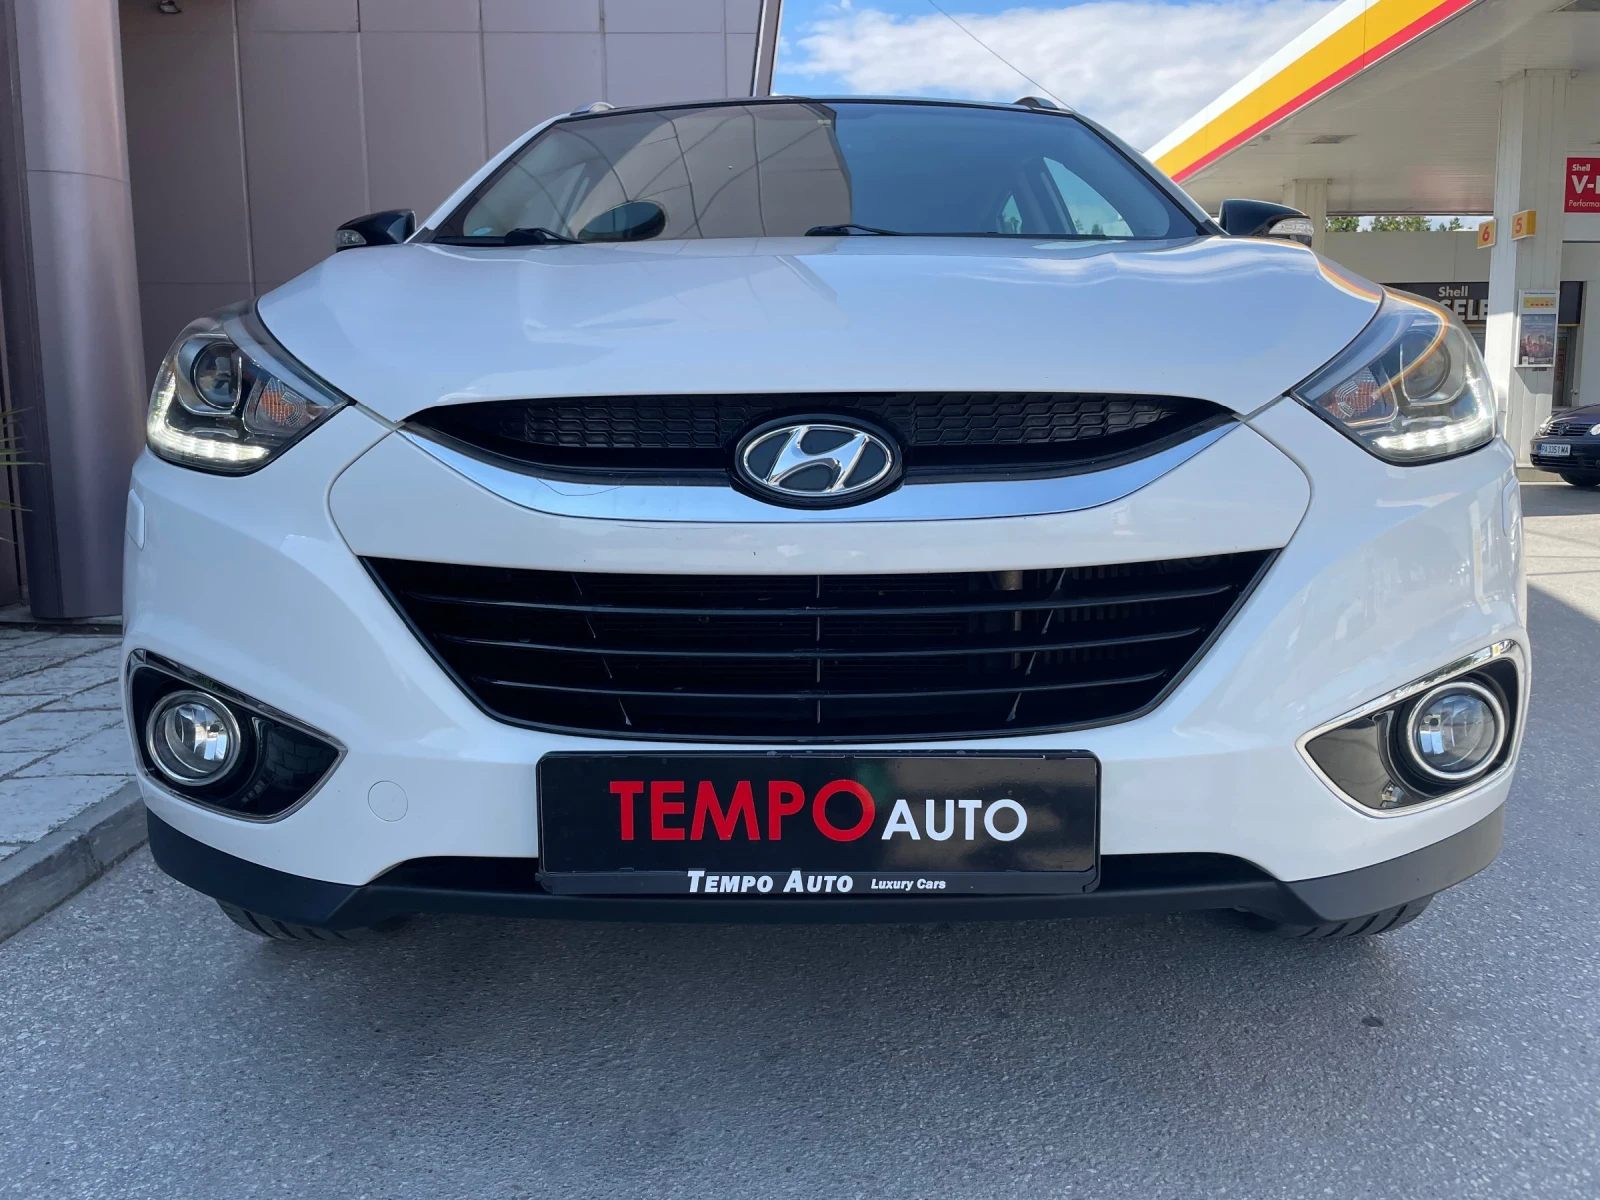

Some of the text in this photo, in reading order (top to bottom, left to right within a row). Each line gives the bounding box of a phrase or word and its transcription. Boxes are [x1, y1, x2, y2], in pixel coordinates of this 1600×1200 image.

[1572, 163, 1591, 171] Shell
[1515, 216, 1523, 234] 5
[1482, 225, 1490, 242] 6
[1438, 285, 1469, 297] Shell
[609, 780, 1028, 842] TEMPO AUTO
[870, 878, 914, 892] Luxury
[916, 878, 947, 890] Cars
